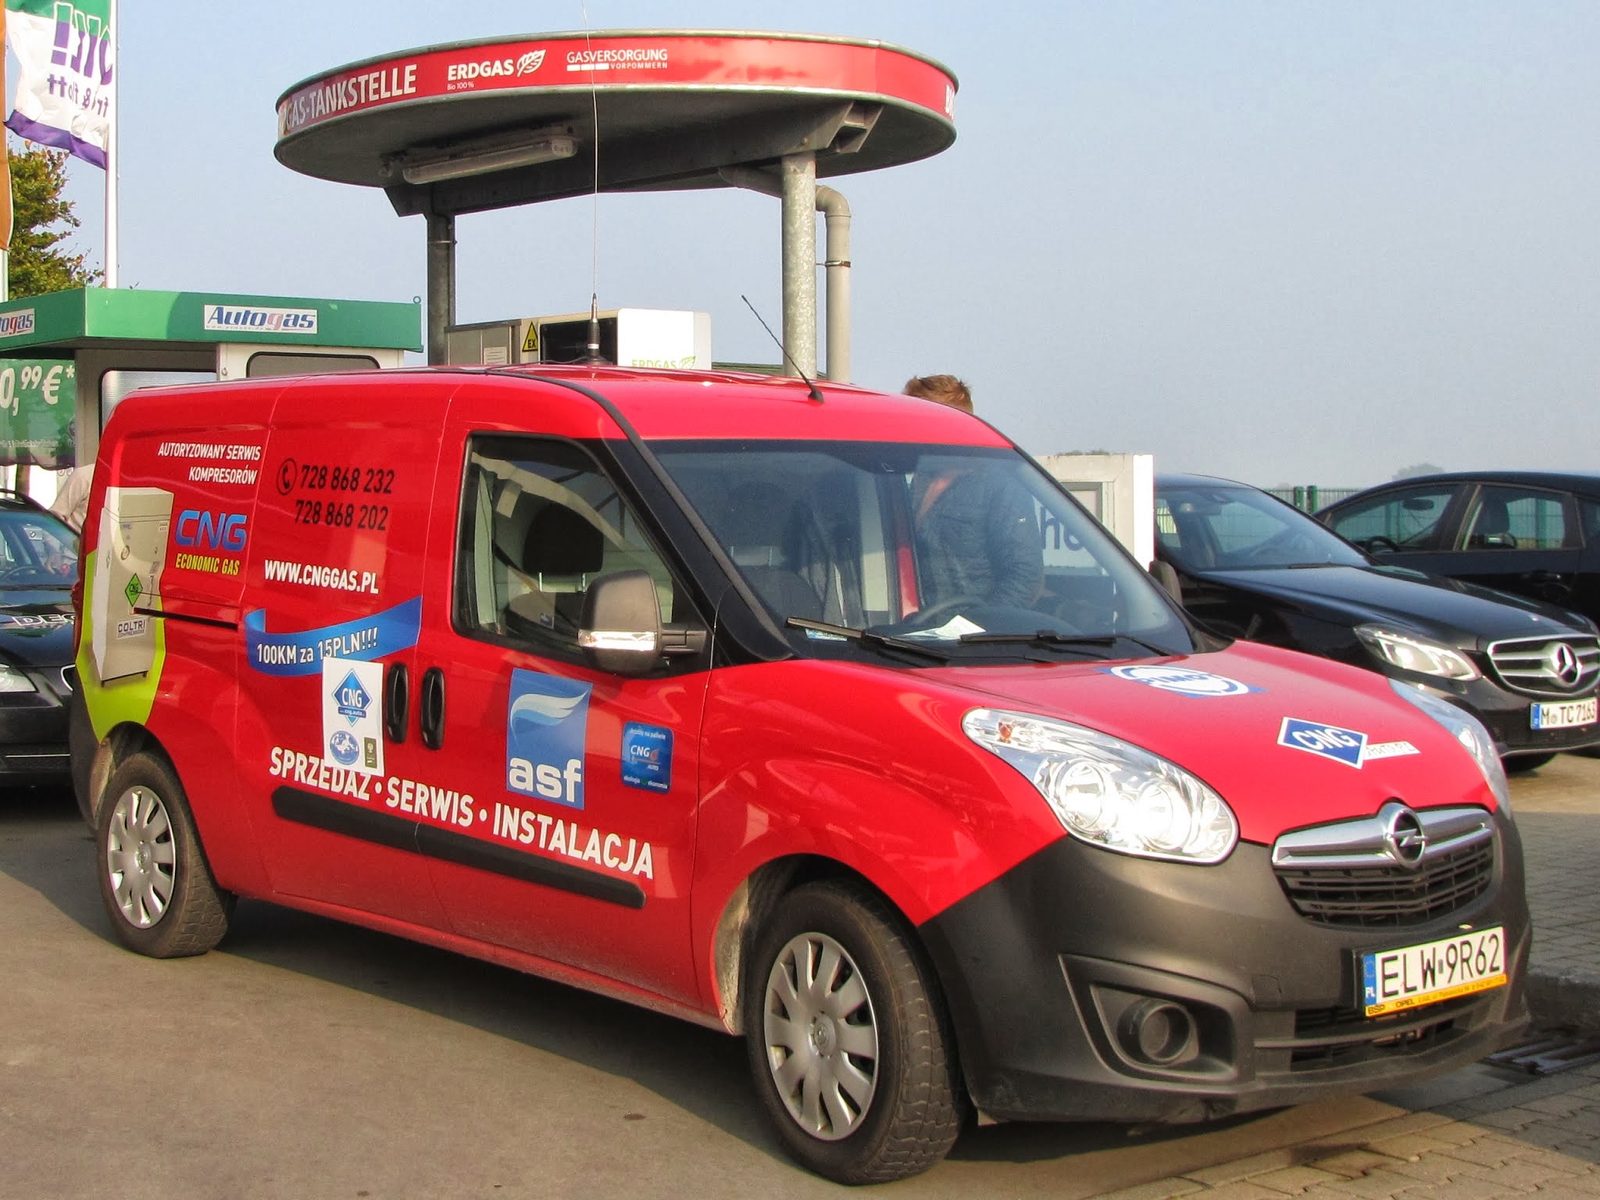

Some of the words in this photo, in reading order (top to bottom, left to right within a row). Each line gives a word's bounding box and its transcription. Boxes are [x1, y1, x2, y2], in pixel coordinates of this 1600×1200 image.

[566, 49, 668, 63] GASVERSORGUNG
[610, 62, 668, 70] VORPOMMERN
[447, 58, 515, 81] ERDGAS
[207, 306, 316, 330] Autogas
[527, 339, 536, 349] EX
[158, 442, 226, 460] AUTORYZOWANY
[226, 445, 261, 462] SERWIS
[188, 465, 258, 485] KOMPRESORÓW
[300, 465, 328, 491] 728
[329, 466, 360, 492] 868
[364, 468, 395, 495] 232
[295, 499, 321, 524] 728
[325, 501, 354, 528] 868
[358, 505, 389, 531] 202
[175, 508, 249, 551] CNG
[175, 553, 220, 573] ECONOMIC
[221, 557, 240, 576] GAS
[264, 560, 379, 594] WWW.CNGGAS.PL
[118, 620, 145, 633] COLTRI
[257, 643, 297, 665] 100KM
[300, 647, 314, 662] za
[318, 627, 378, 660] 15PLN!!!
[341, 688, 363, 708] CNG
[1541, 708, 1550, 725] M
[1291, 727, 1361, 751] CNG
[630, 745, 651, 758] CNG
[509, 758, 582, 802] asf
[386, 777, 474, 828] SERWIS
[493, 803, 655, 880] INSTALACJA
[1381, 947, 1436, 998] ELW
[1445, 933, 1500, 984] 9R62
[1365, 986, 1376, 998] PL
